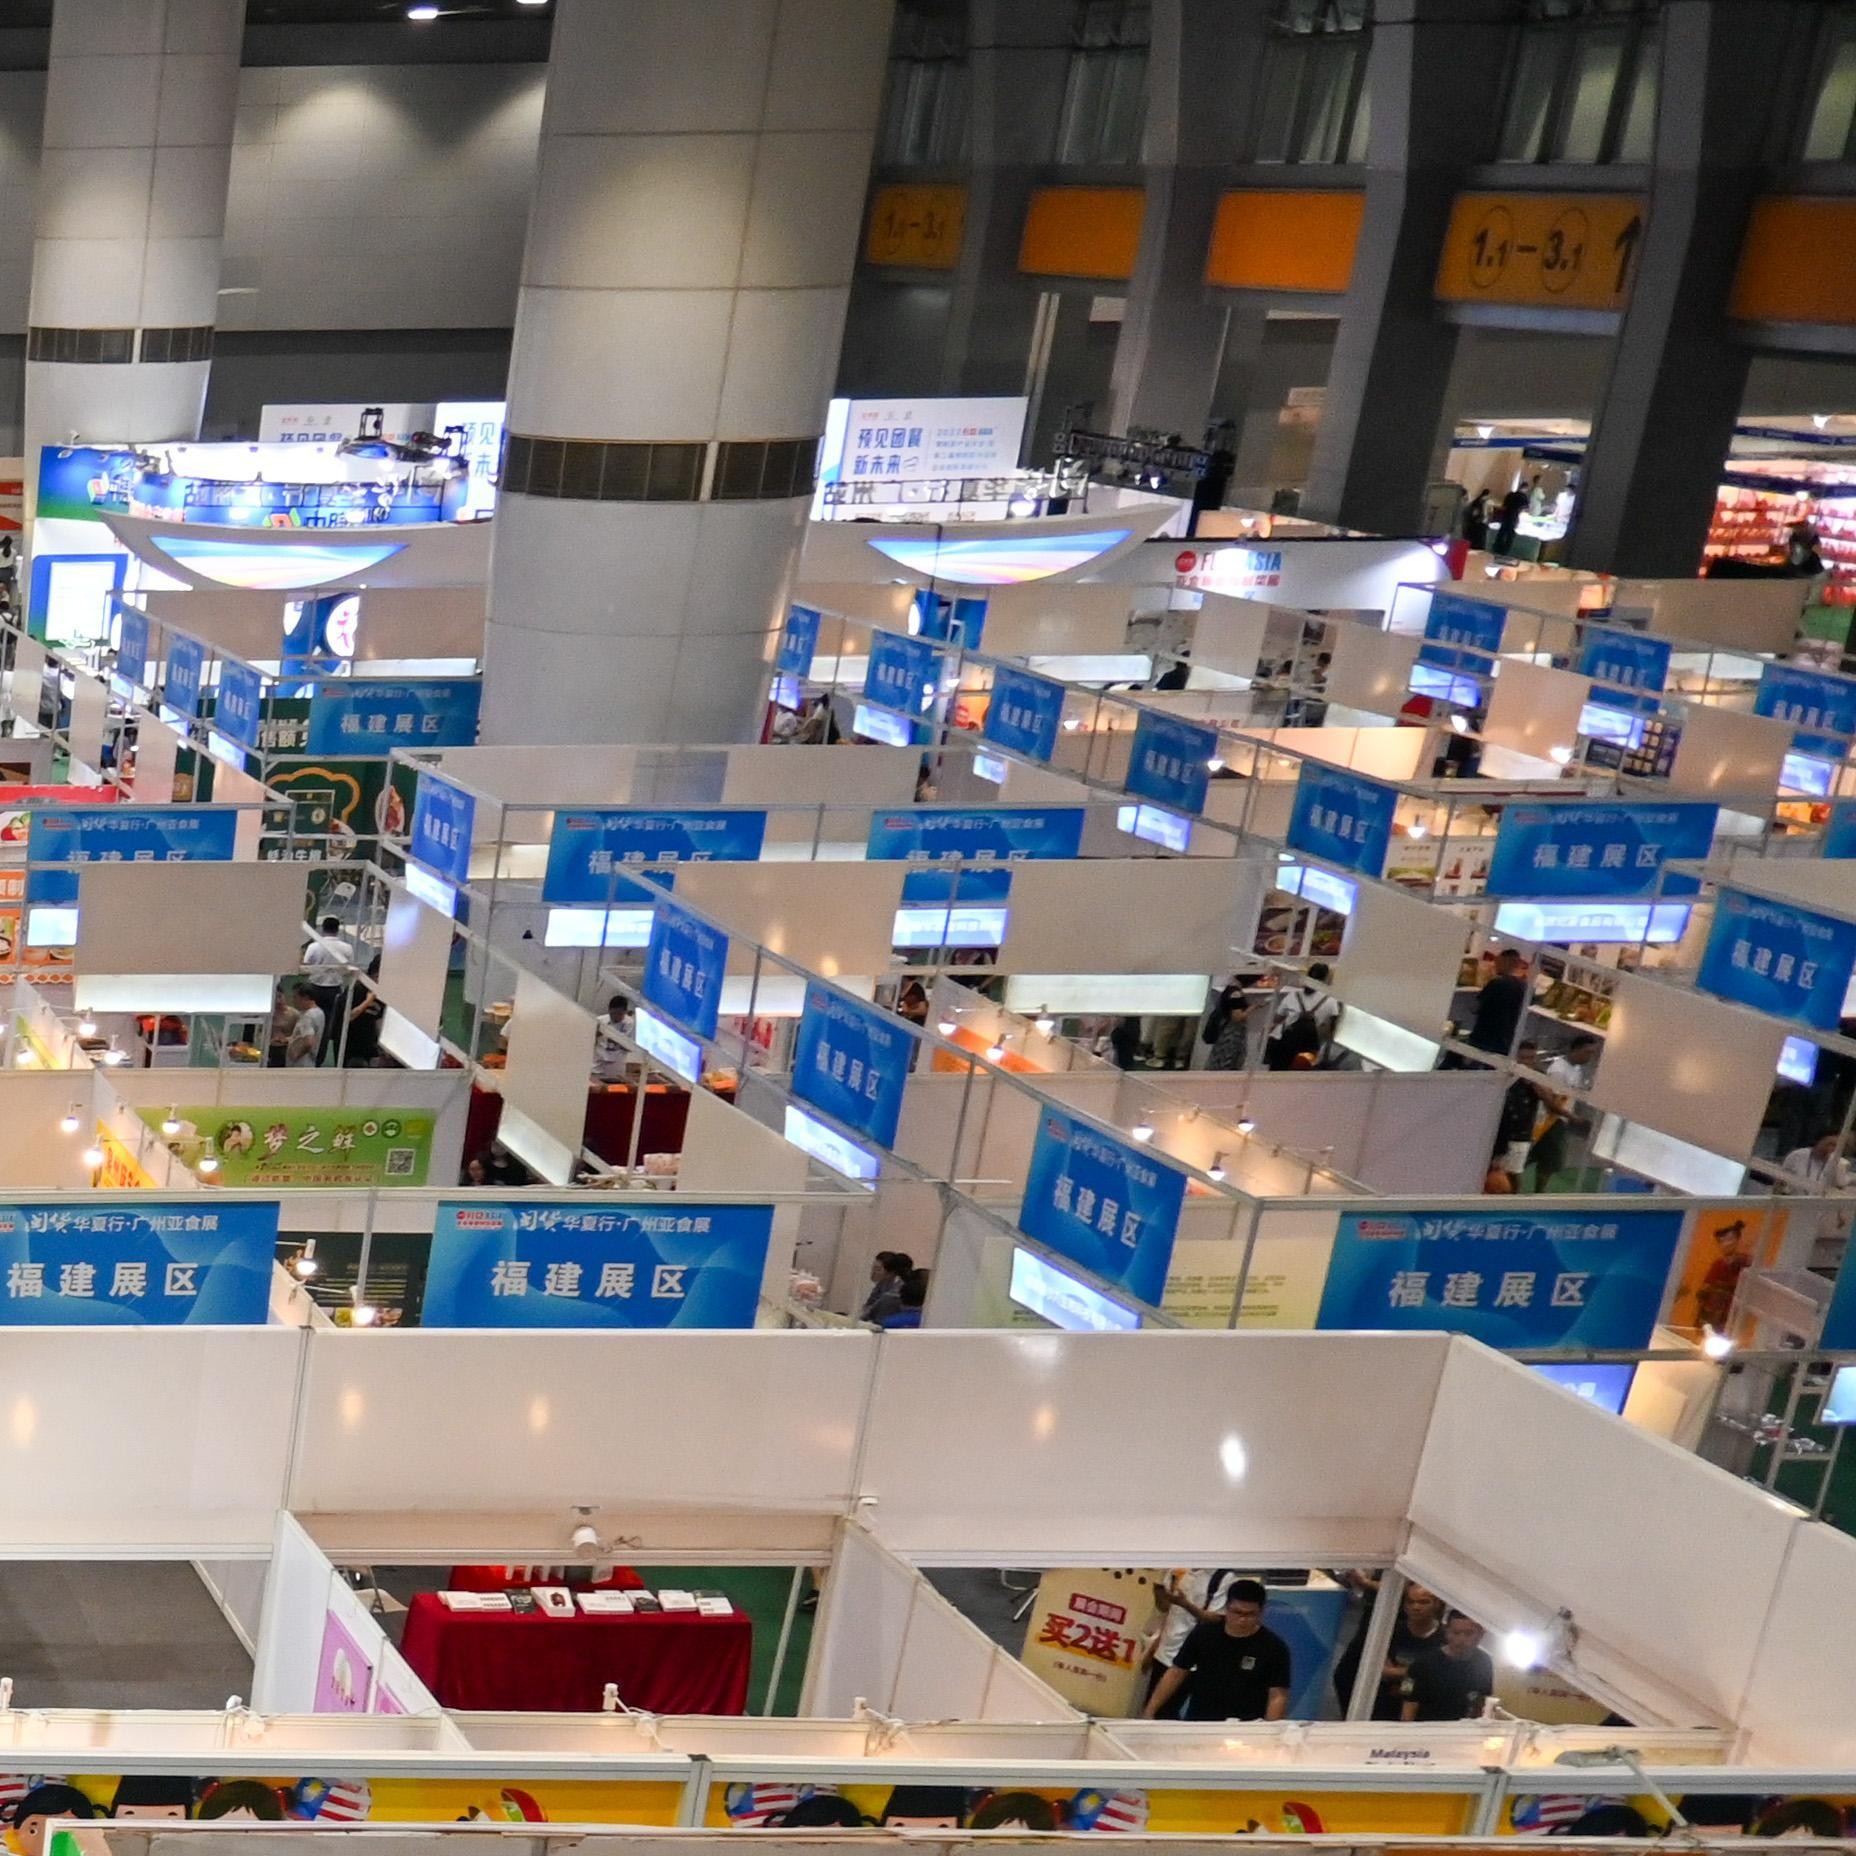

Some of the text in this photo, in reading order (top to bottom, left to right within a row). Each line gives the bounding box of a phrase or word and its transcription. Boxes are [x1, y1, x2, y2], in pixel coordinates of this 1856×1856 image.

[340, 713, 441, 735] 福建展区
[1532, 843, 1664, 870] 福建展区
[660, 949, 706, 999] 福建展区
[1731, 937, 1818, 992] 福建展区
[814, 1040, 882, 1102] 福建展区
[1052, 1173, 1141, 1250] 福建展区
[7, 1261, 200, 1299] 福建展区
[490, 1259, 688, 1300] 福建展区
[1388, 1269, 1592, 1309] 福建展区
[1039, 1612, 1137, 1665] 买2送1
[1369, 1748, 1431, 1762] Malaysia
